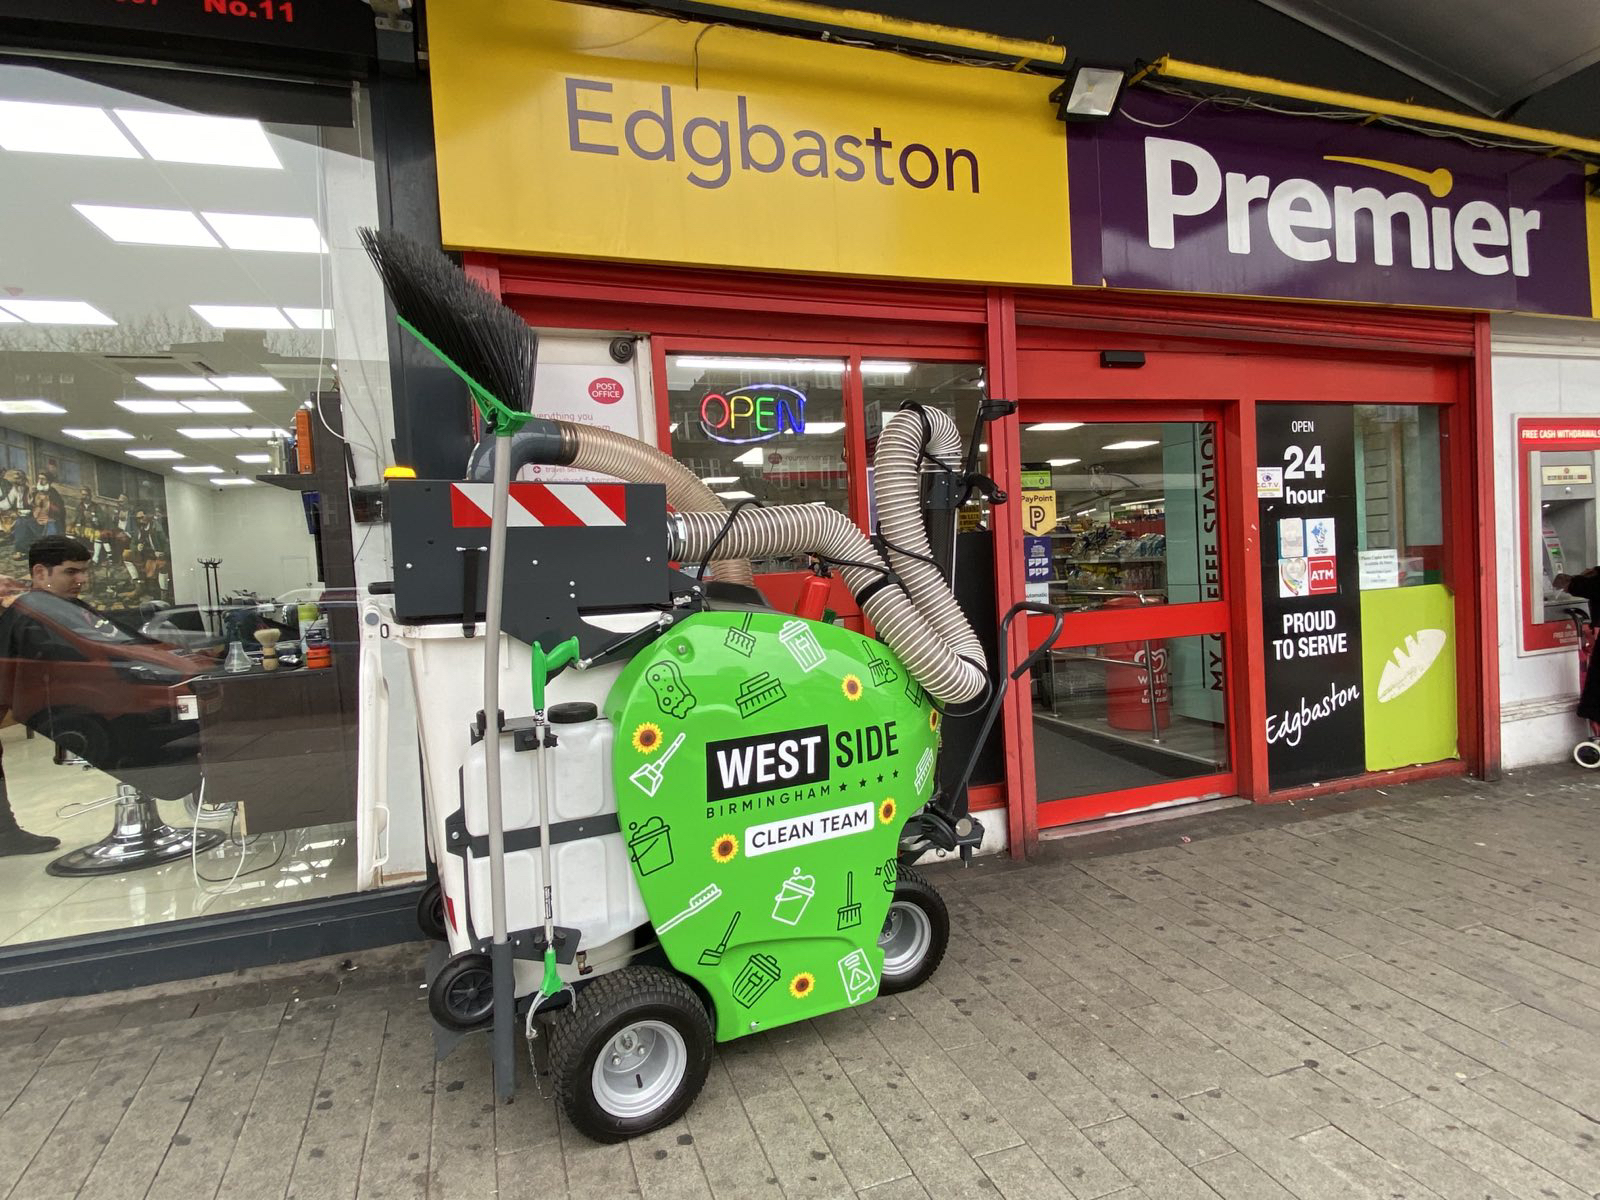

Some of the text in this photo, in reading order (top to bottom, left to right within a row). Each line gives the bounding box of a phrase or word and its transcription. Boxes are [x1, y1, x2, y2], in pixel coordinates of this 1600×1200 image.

[204, 0, 294, 22] No.11
[565, 77, 980, 193] Edgbaston
[1145, 136, 1540, 277] Premier
[592, 390, 620, 398] OFFICE
[596, 383, 616, 391] POST
[534, 412, 593, 422] verything you
[702, 393, 806, 435] OPEN
[1291, 421, 1315, 432] OPEN
[1522, 430, 1539, 438] FREE
[1540, 430, 1556, 438] CASH
[1284, 445, 1325, 479] 24
[1286, 486, 1325, 504] hour
[1311, 569, 1334, 581] ATM
[1283, 610, 1336, 634] PROUD
[1272, 633, 1347, 660] TO SERVE
[1209, 651, 1224, 692] MY
[1266, 682, 1360, 746] Edgbaston
[716, 721, 899, 789] WEST SIDE
[706, 785, 830, 819] BIRMINGHAM
[752, 810, 868, 848] CLEAN TEAM
